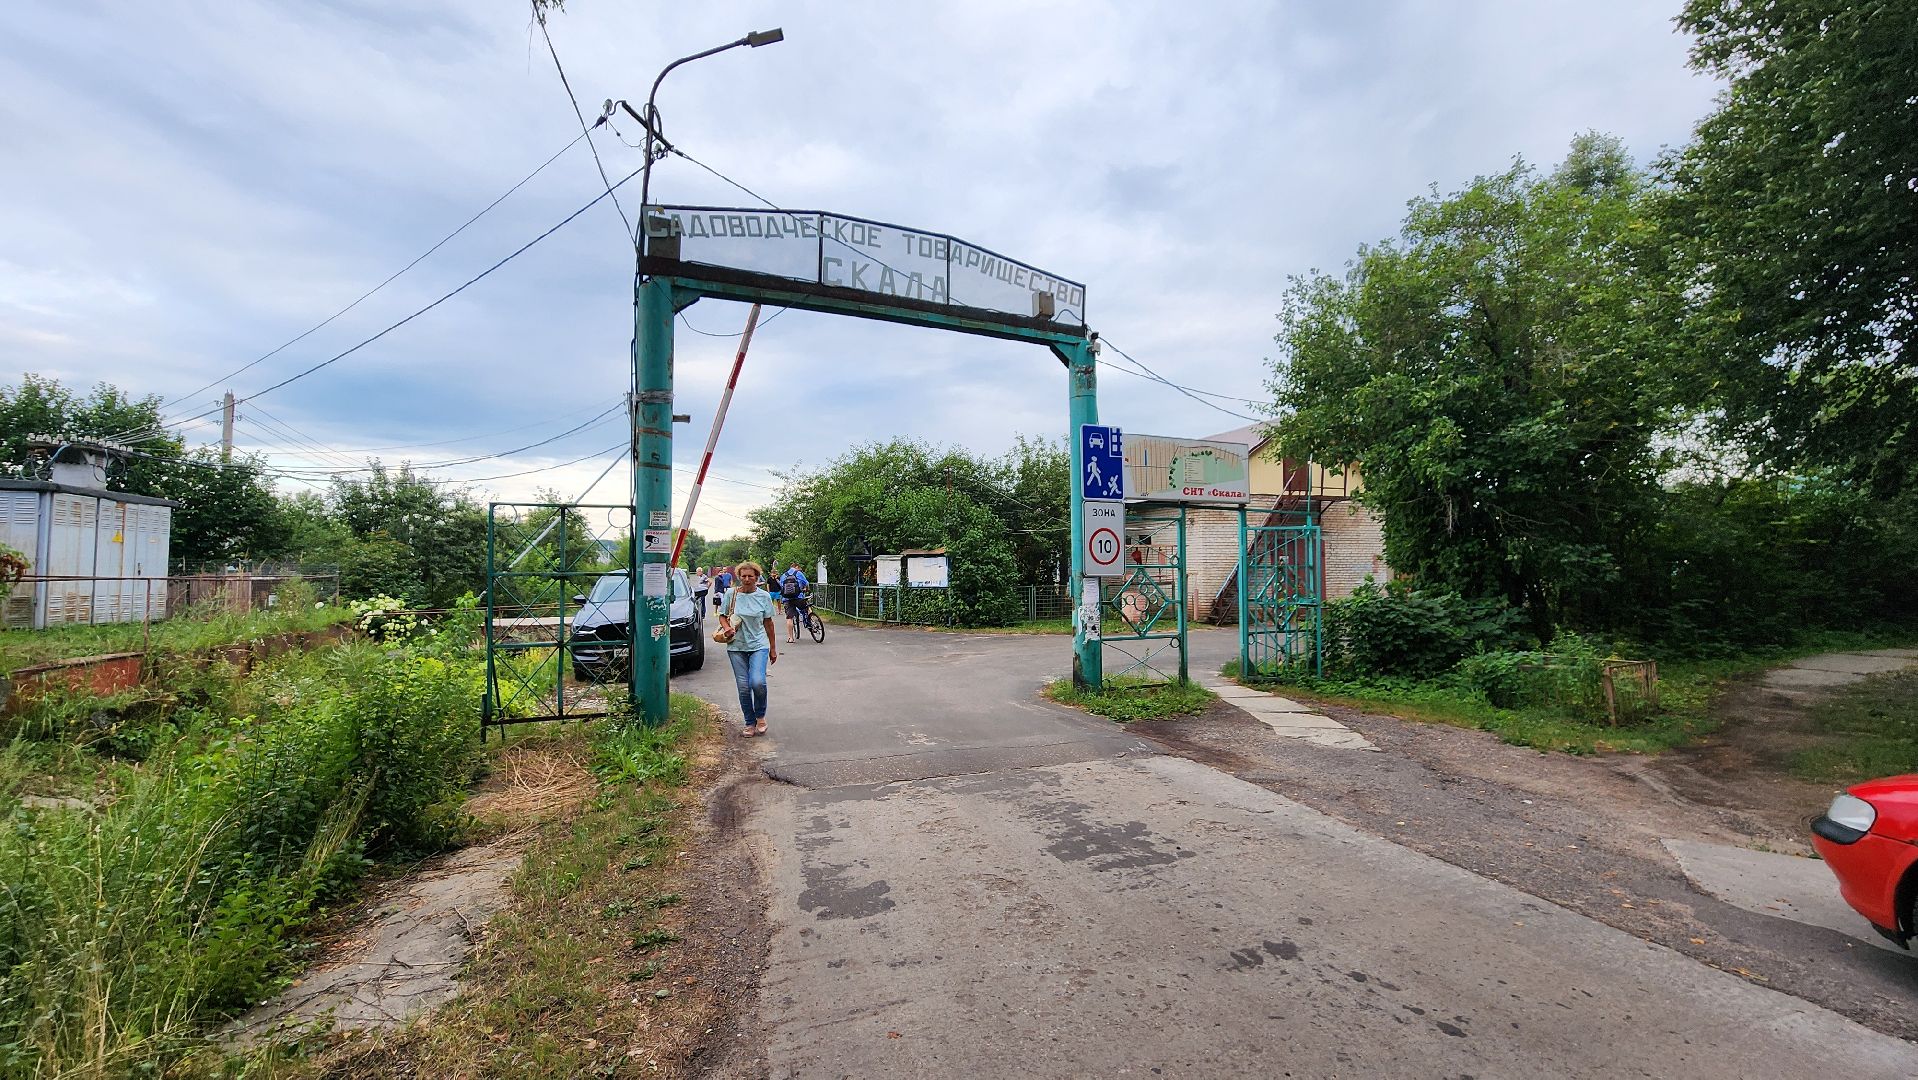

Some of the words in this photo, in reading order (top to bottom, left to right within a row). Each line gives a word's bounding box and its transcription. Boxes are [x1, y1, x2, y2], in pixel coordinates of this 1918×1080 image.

[642, 205, 882, 249] САДОВОДЧЕСКОЕ
[902, 233, 1083, 308] ТОВАРИЩЕСТВО
[823, 256, 947, 304] СКАЛА
[1183, 487, 1205, 496] СНТ
[1208, 488, 1247, 498] «Скала»
[1092, 508, 1116, 517] ЗОНА
[1098, 539, 1112, 554] 10
